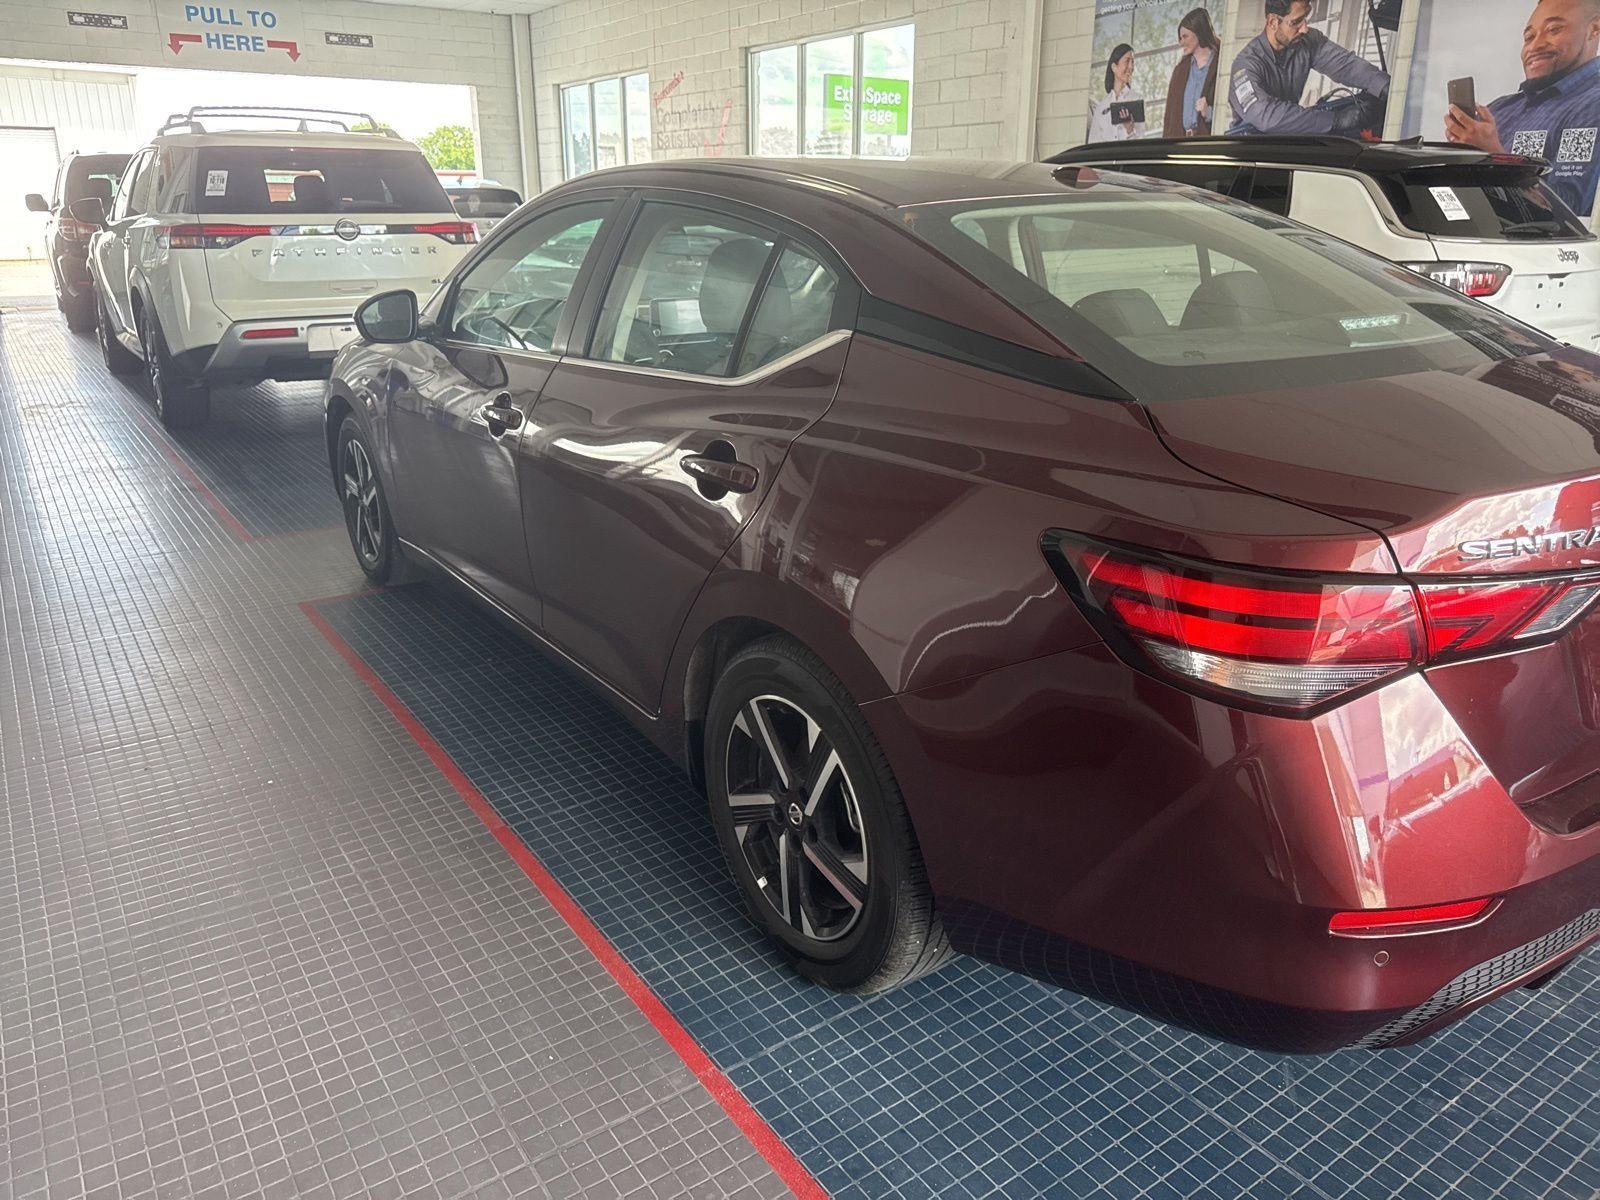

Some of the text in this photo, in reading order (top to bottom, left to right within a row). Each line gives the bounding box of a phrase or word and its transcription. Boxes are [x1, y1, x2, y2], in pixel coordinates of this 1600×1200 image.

[185, 5, 277, 28] PULL TO
[205, 33, 265, 52] HERE
[866, 87, 901, 106] Space
[252, 246, 437, 258] PATHFINDER
[1558, 248, 1580, 264] Jeep
